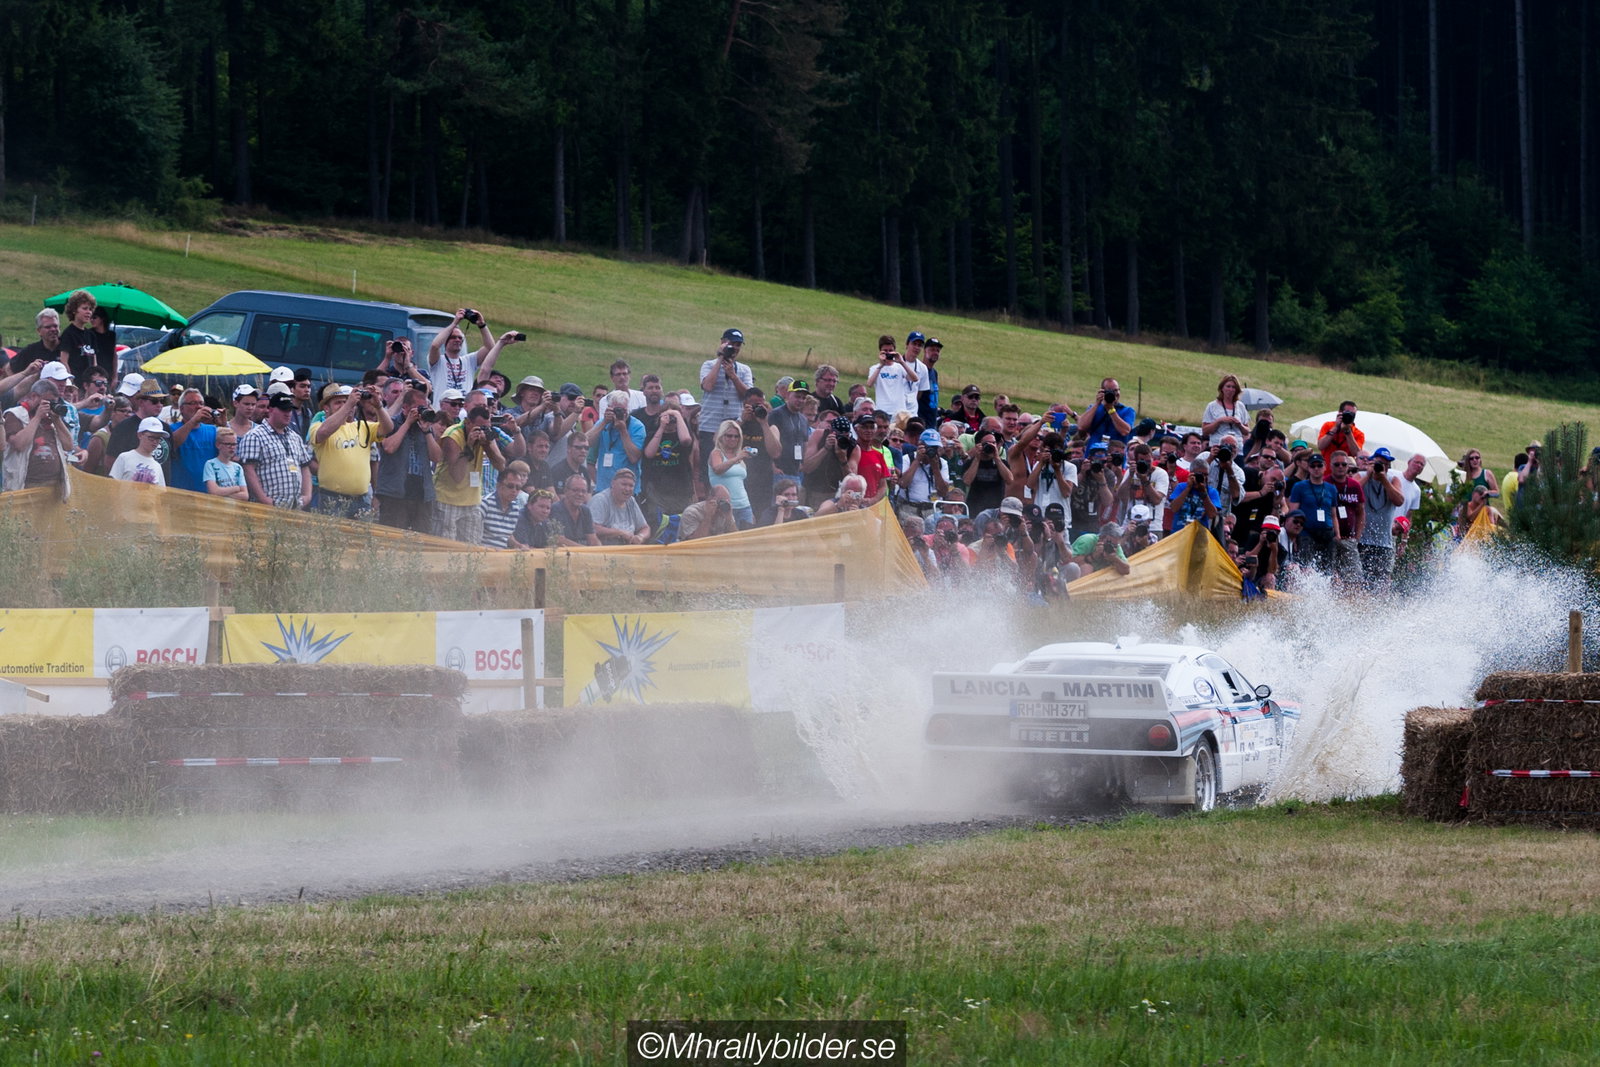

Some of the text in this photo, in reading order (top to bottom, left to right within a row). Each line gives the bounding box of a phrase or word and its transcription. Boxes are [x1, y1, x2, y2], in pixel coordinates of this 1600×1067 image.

[47, 661, 85, 674] Tradition
[474, 648, 522, 672] BOSC
[949, 679, 1155, 699] LANCIA MARTINI
